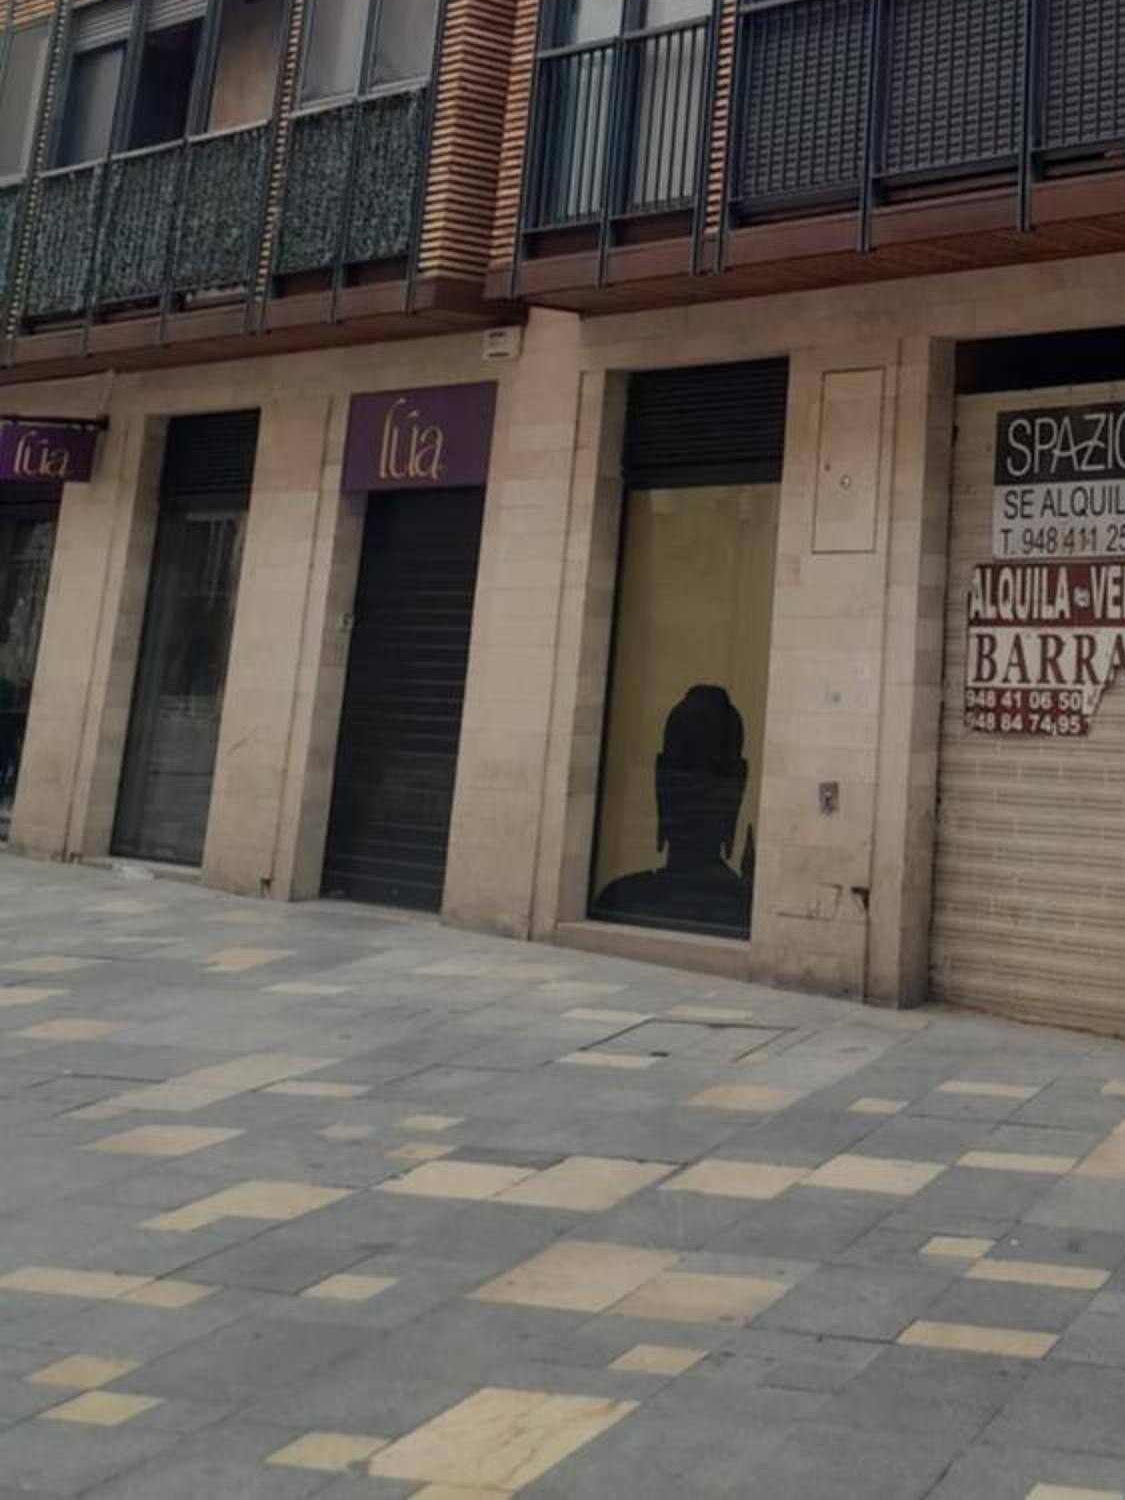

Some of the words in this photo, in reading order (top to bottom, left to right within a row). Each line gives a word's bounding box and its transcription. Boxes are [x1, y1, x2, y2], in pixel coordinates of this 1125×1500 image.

[1004, 488, 1035, 520] SE
[1022, 526, 1058, 554] 948
[1063, 526, 1097, 552] 411
[970, 566, 1070, 621] ALQUILA
